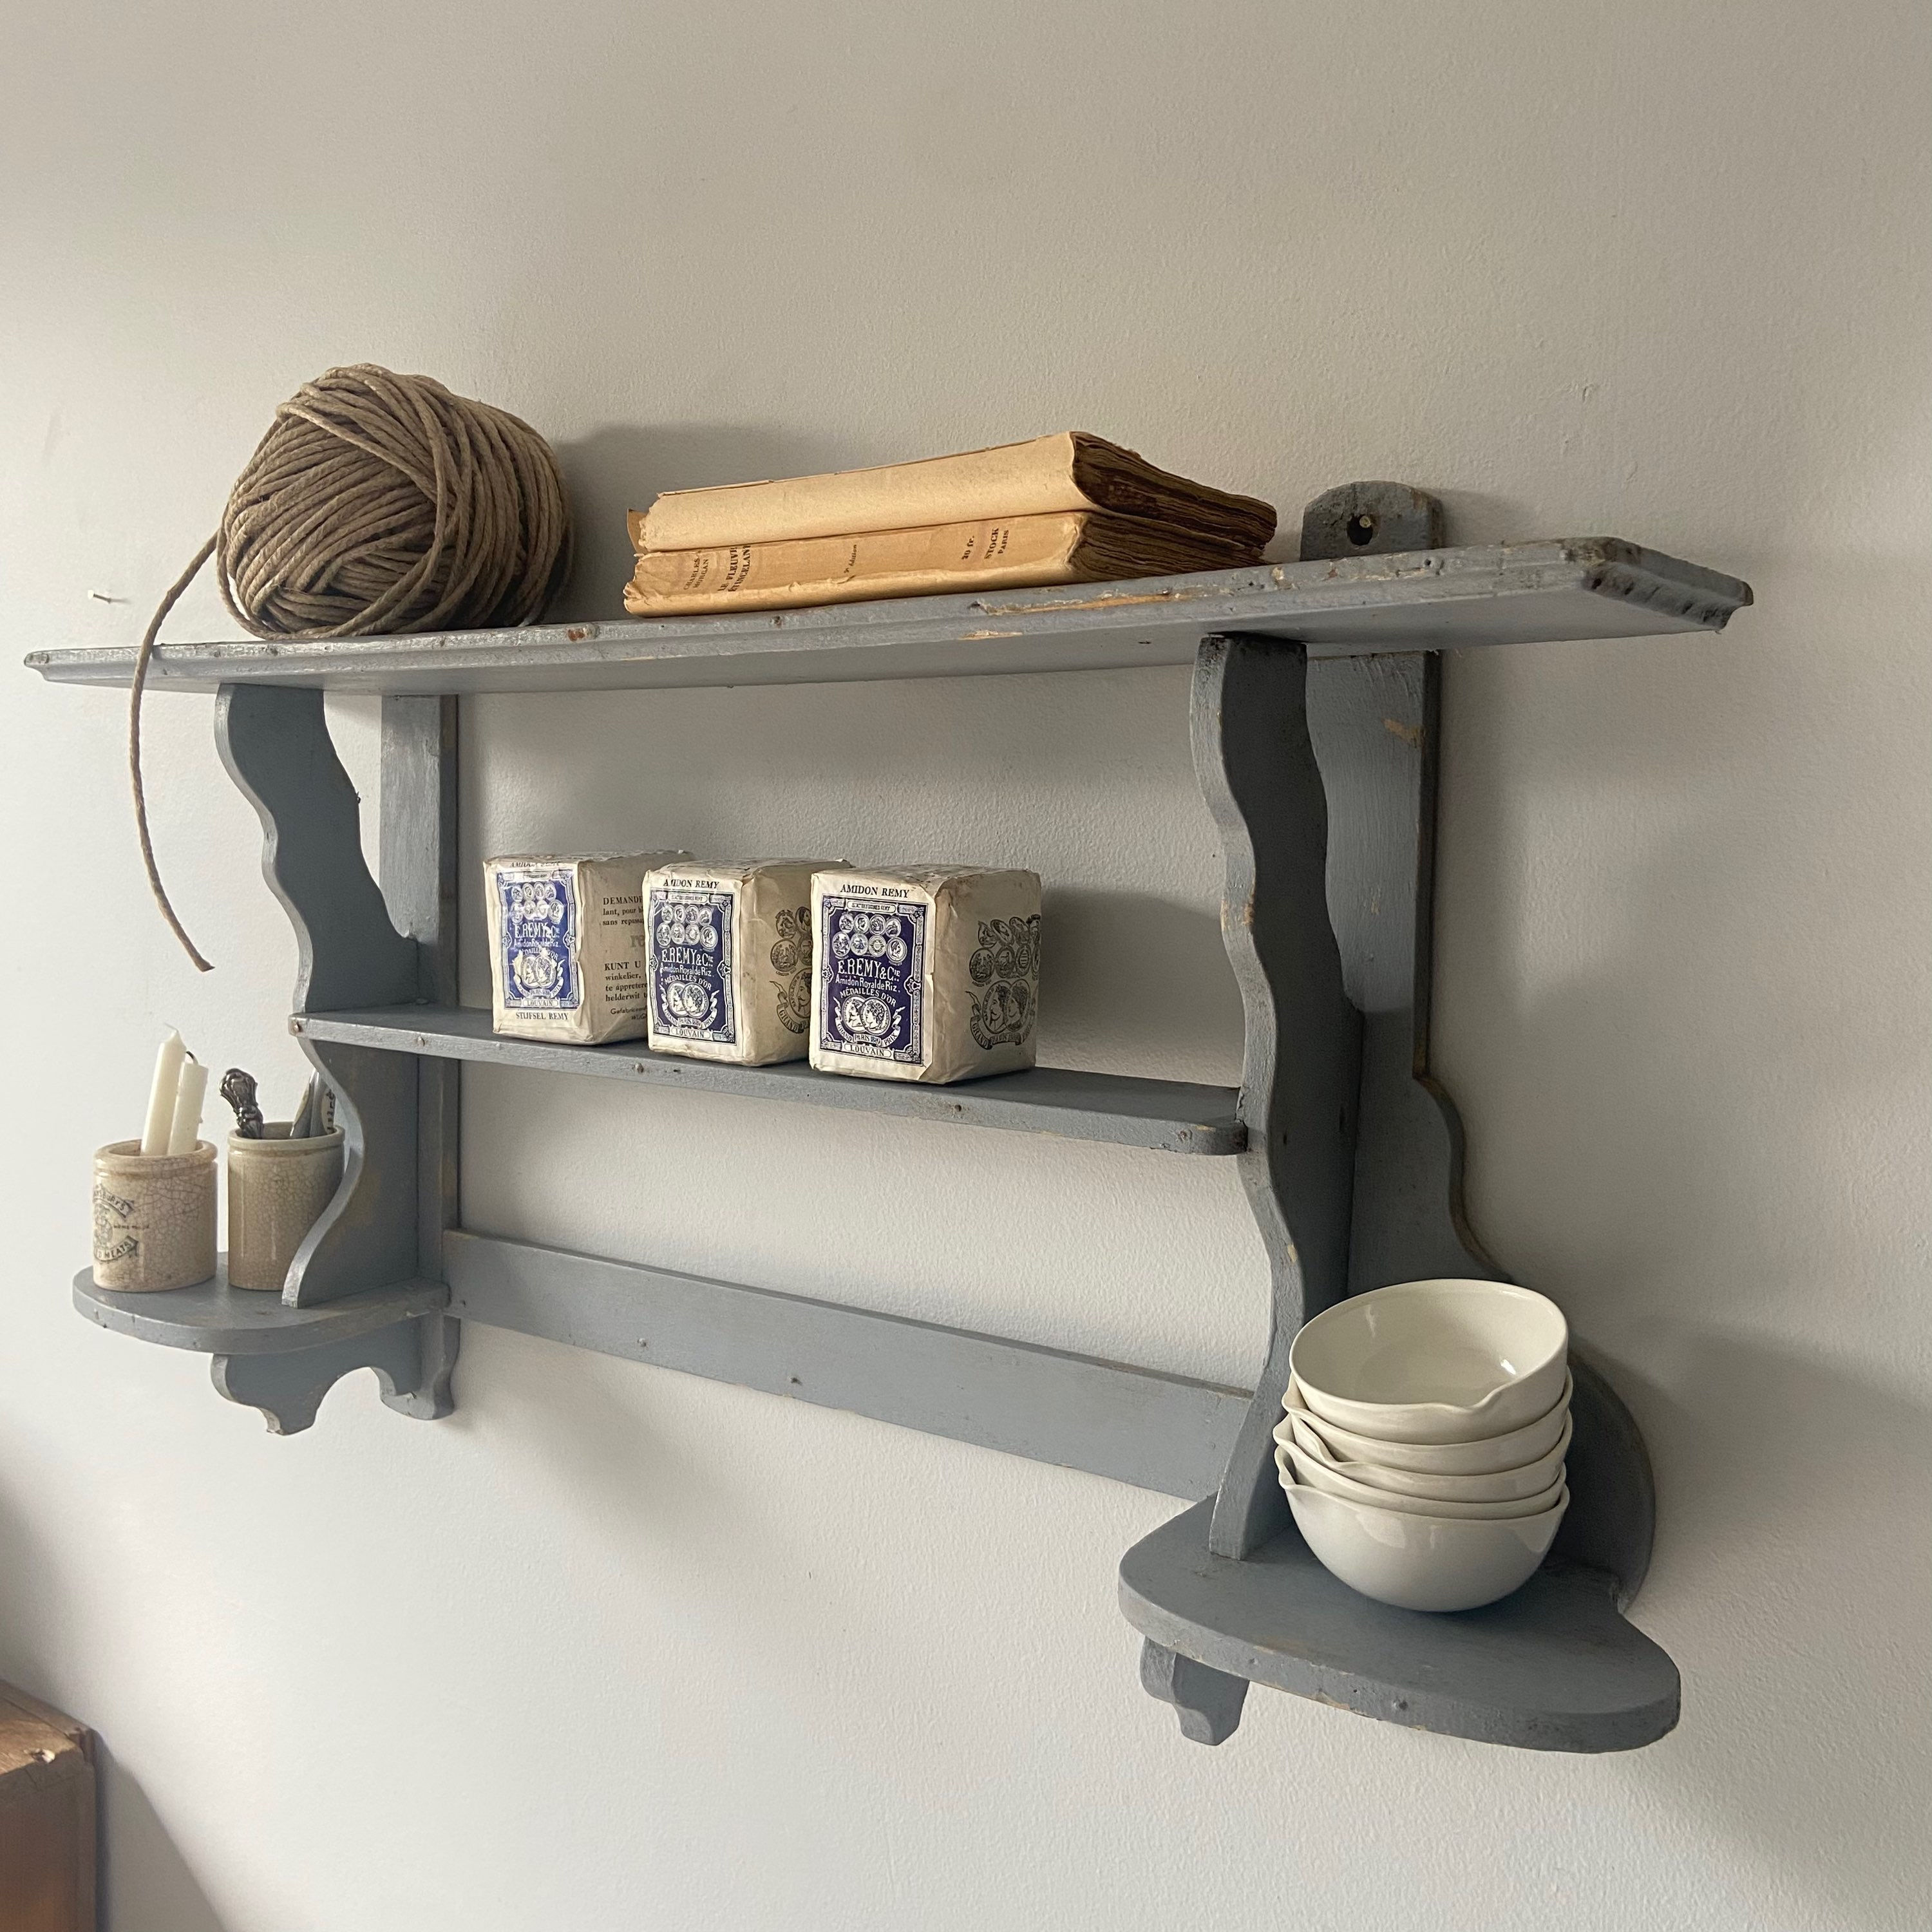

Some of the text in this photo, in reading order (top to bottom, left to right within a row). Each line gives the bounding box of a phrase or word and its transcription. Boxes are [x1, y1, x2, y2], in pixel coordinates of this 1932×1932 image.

[984, 528, 999, 559] STOCK
[998, 530, 1009, 554] PARIS
[683, 558, 699, 590] CHARLES
[693, 559, 708, 588] MORGAN
[717, 583, 729, 591] LE
[696, 880, 719, 889] REMY
[840, 884, 909, 898] AMIDON REMY
[605, 961, 629, 971] KUNT
[835, 974, 858, 987] Amidon
[859, 978, 876, 989] Royal
[605, 992, 639, 1001] helderwit
[840, 987, 896, 1007] MÉDAILLES D'OR
[837, 1023, 852, 1041] GRAND
[884, 1032, 897, 1046] PRIX
[850, 1044, 884, 1057] LOUVAIN
